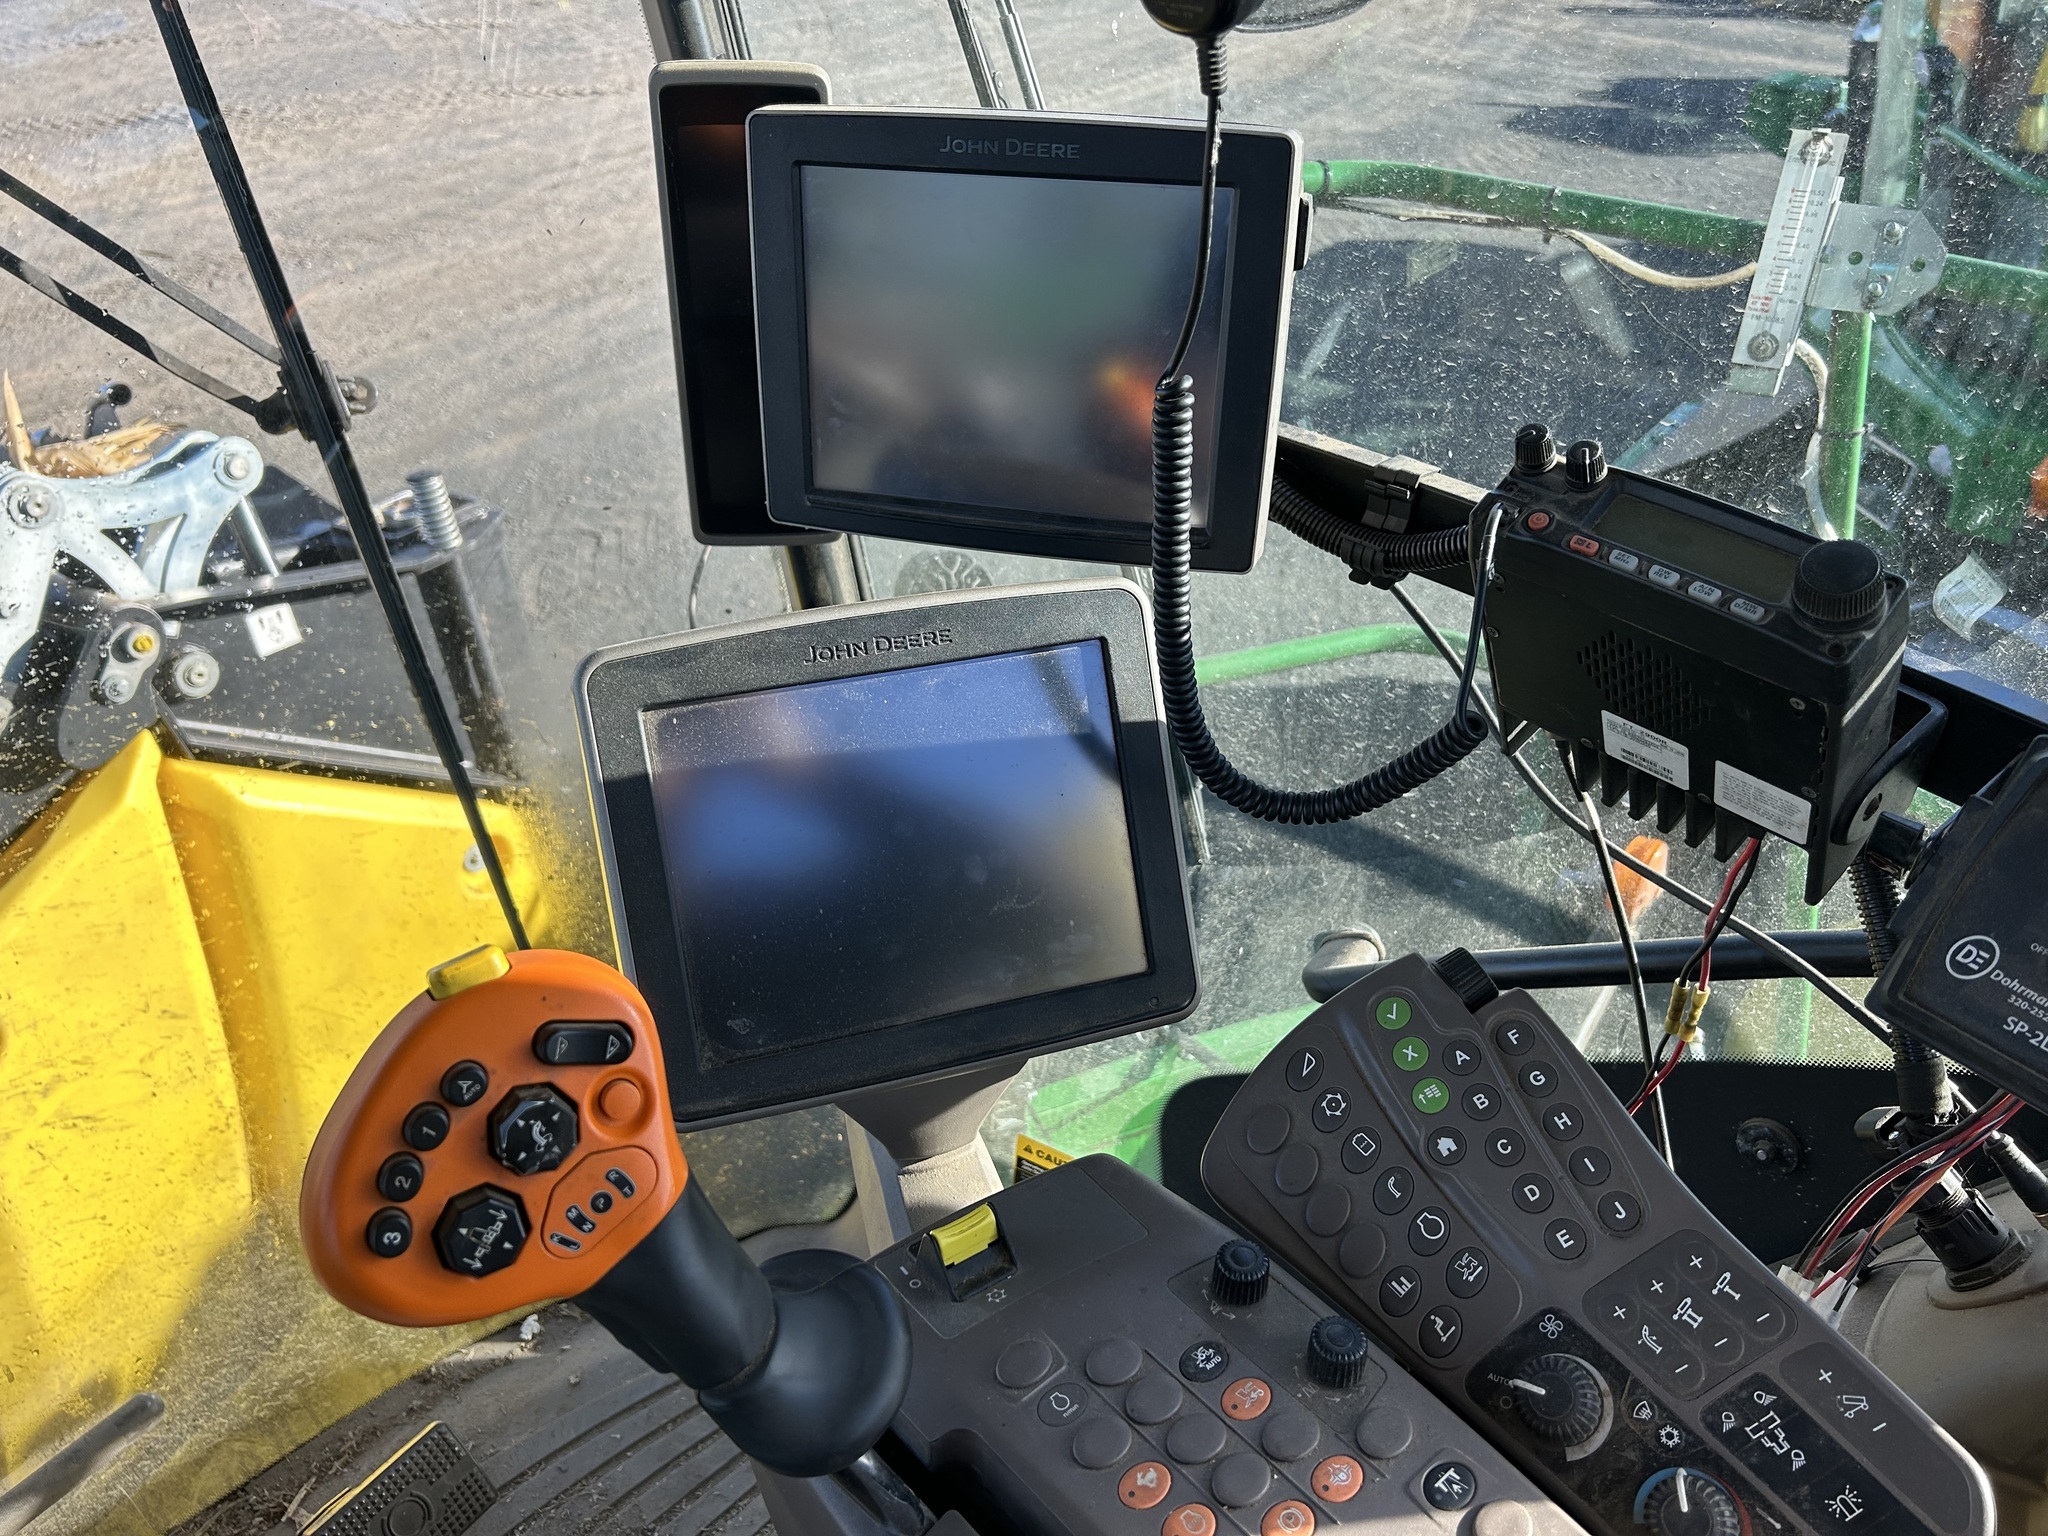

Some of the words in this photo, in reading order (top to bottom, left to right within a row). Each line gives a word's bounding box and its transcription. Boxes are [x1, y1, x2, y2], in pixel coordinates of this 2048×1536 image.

[939, 135, 999, 155] JOHN
[1005, 138, 1081, 159] DEERE
[1616, 552, 1631, 560] SET
[1653, 571, 1670, 580] REV
[1658, 567, 1672, 576] DW
[1693, 587, 1713, 597] LOW
[804, 641, 869, 665] JOHN
[873, 629, 953, 655] DEERE
[1507, 1028, 1520, 1045] F
[1455, 1050, 1471, 1065] A
[1529, 1070, 1546, 1086] G
[463, 1083, 481, 1101] AUTO
[1472, 1093, 1490, 1110] B
[1553, 1112, 1572, 1130] H
[421, 1126, 437, 1137] 1
[1496, 1139, 1512, 1154] C
[1036, 1149, 1068, 1166] CAU
[1583, 1157, 1595, 1172] I
[394, 1175, 412, 1189] 2
[608, 1170, 620, 1181] R
[622, 1185, 632, 1196] T
[1523, 1184, 1540, 1201] D
[596, 1197, 605, 1209] P
[1614, 1201, 1626, 1220] J
[566, 1207, 580, 1219] M
[582, 1221, 593, 1233] N
[382, 1231, 402, 1246] 3
[552, 1234, 562, 1242] K
[1555, 1229, 1574, 1249] E
[1205, 1355, 1222, 1370] AUTO
[1487, 1372, 1510, 1386] AUTO
